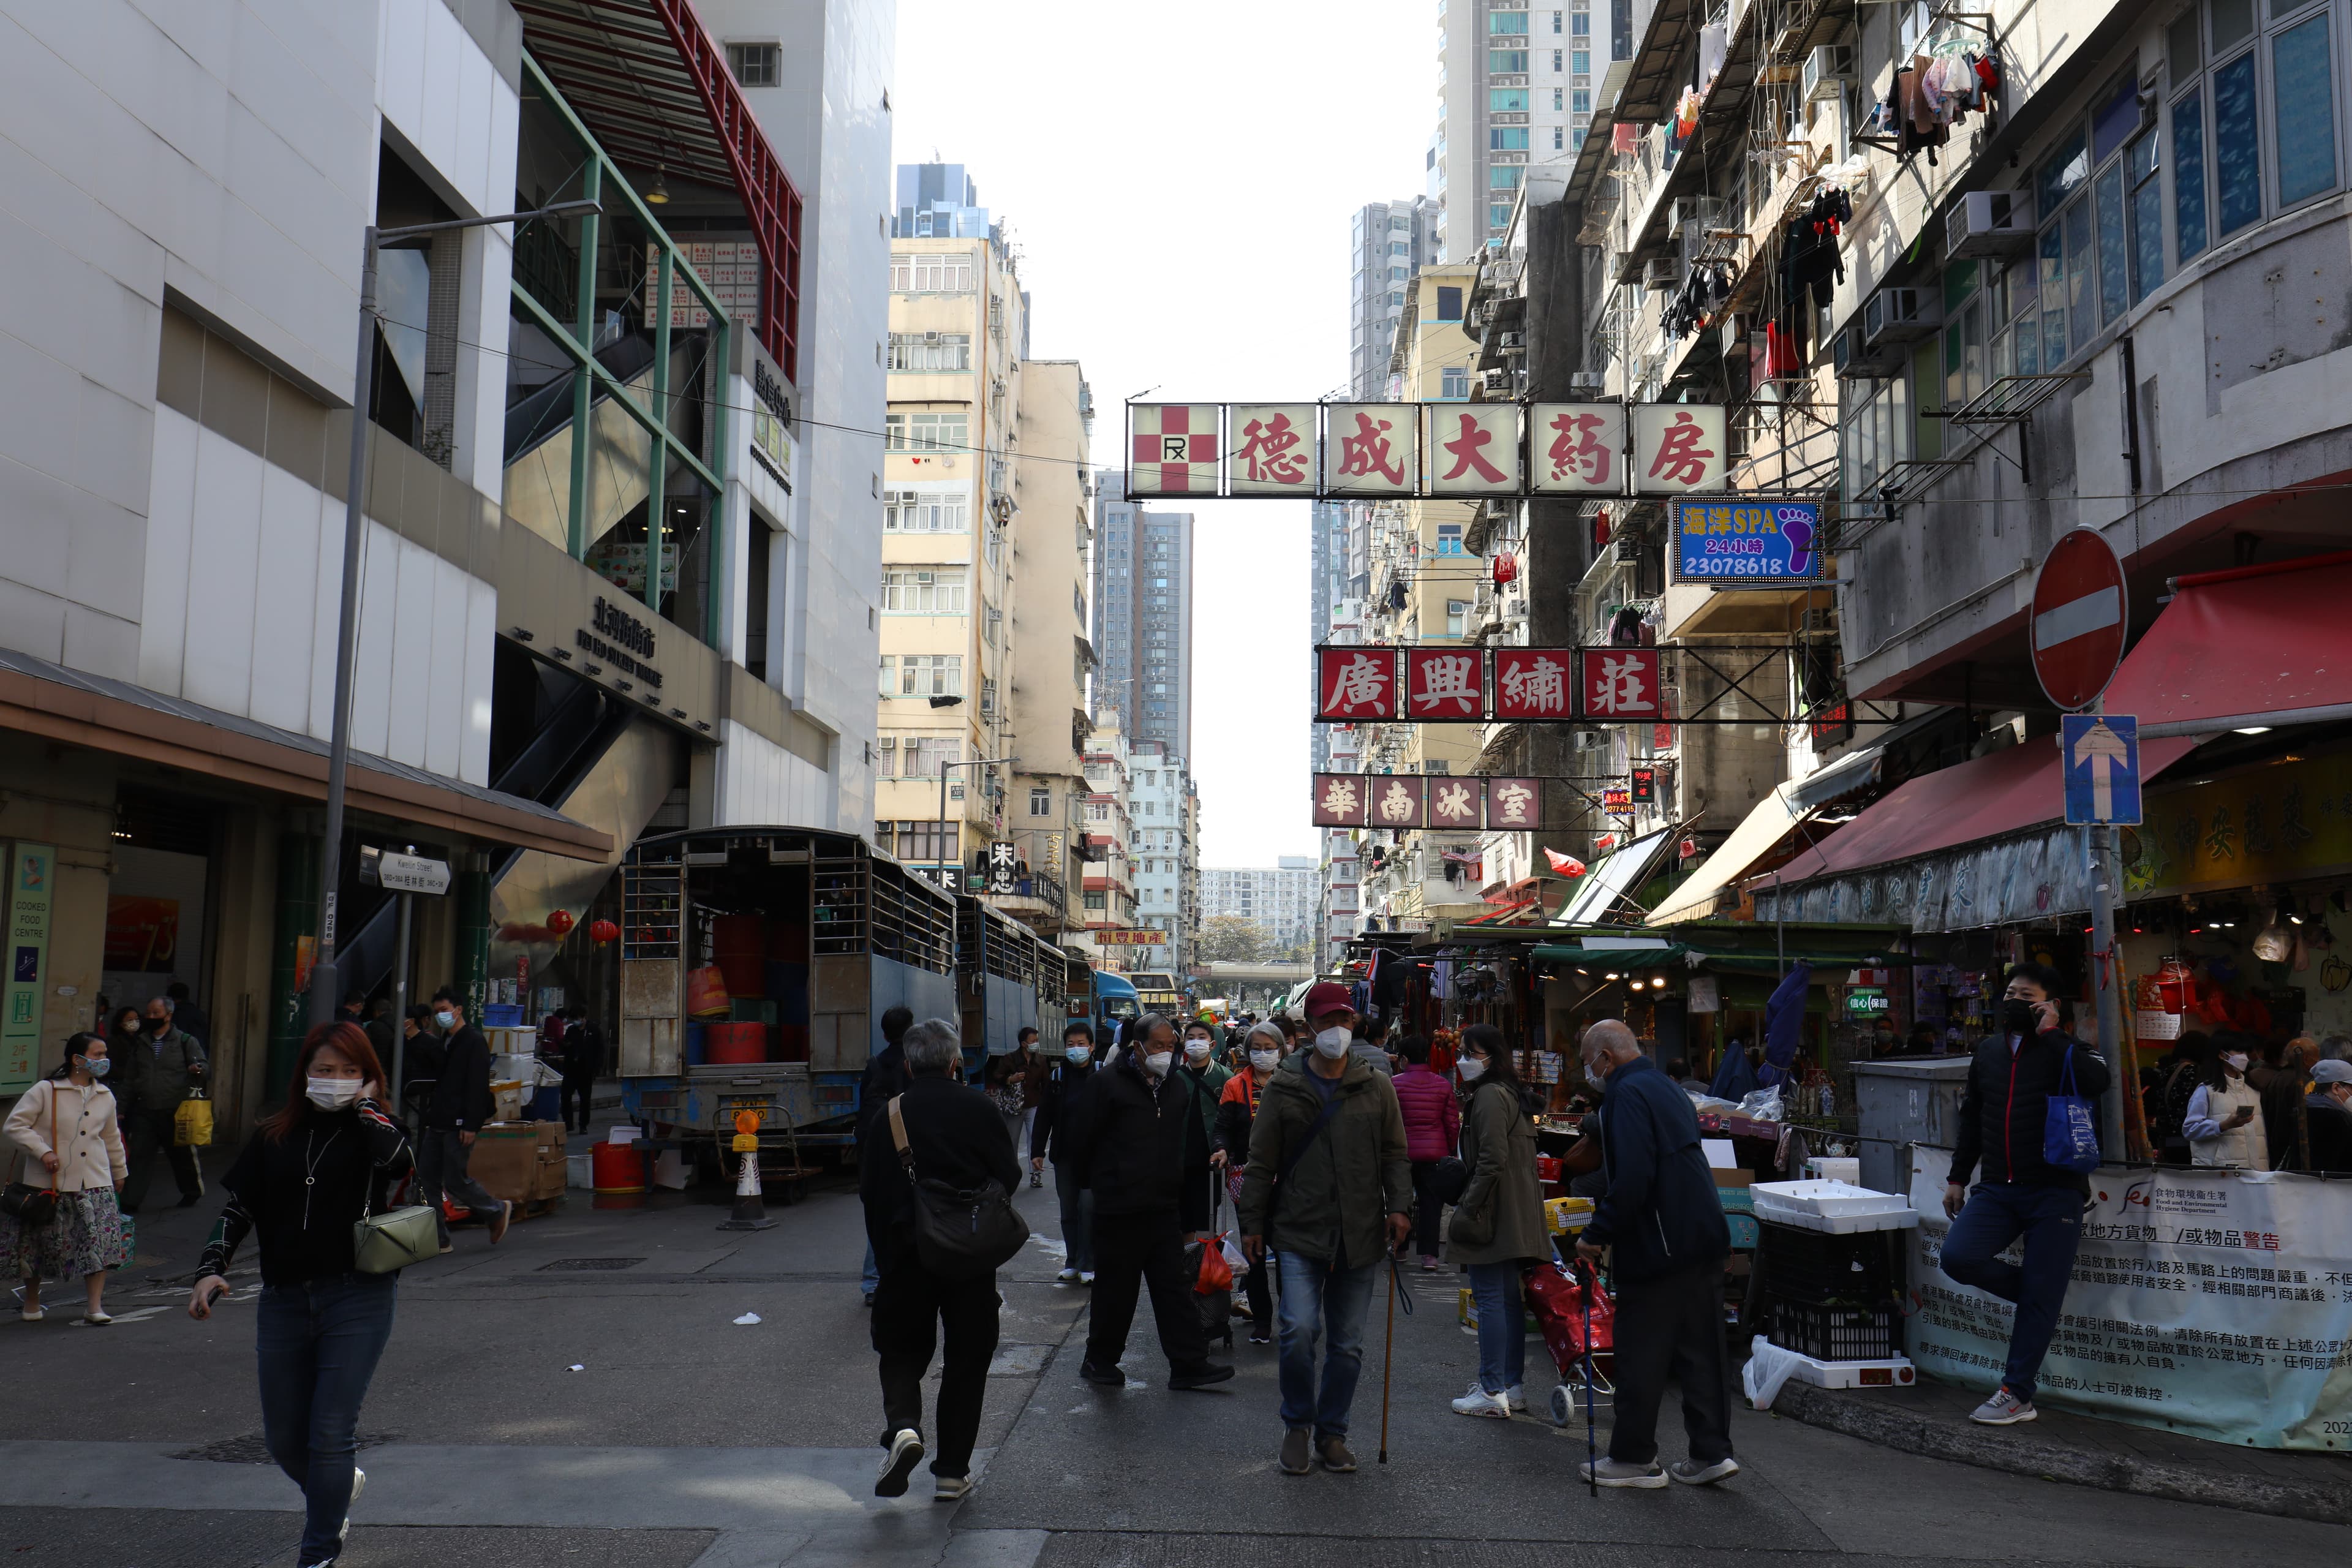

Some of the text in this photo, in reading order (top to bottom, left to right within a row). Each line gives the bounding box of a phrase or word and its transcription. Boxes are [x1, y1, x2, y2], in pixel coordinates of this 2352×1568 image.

[1683, 507, 1778, 536] 海洋SPA
[1705, 538, 1765, 555] 24小時
[1685, 557, 1782, 575] 23078618
[1321, 777, 1534, 824] 華南冰室
[417, 862, 432, 872] Street
[17, 901, 46, 912] COOKED
[20, 915, 40, 925] FOOD
[15, 928, 43, 938] CENTRE
[12, 1045, 27, 1057] 2/F
[9, 1060, 28, 1073] 二樓
[734, 1110, 765, 1120] 80
[2323, 1421, 2352, 1434] 202
